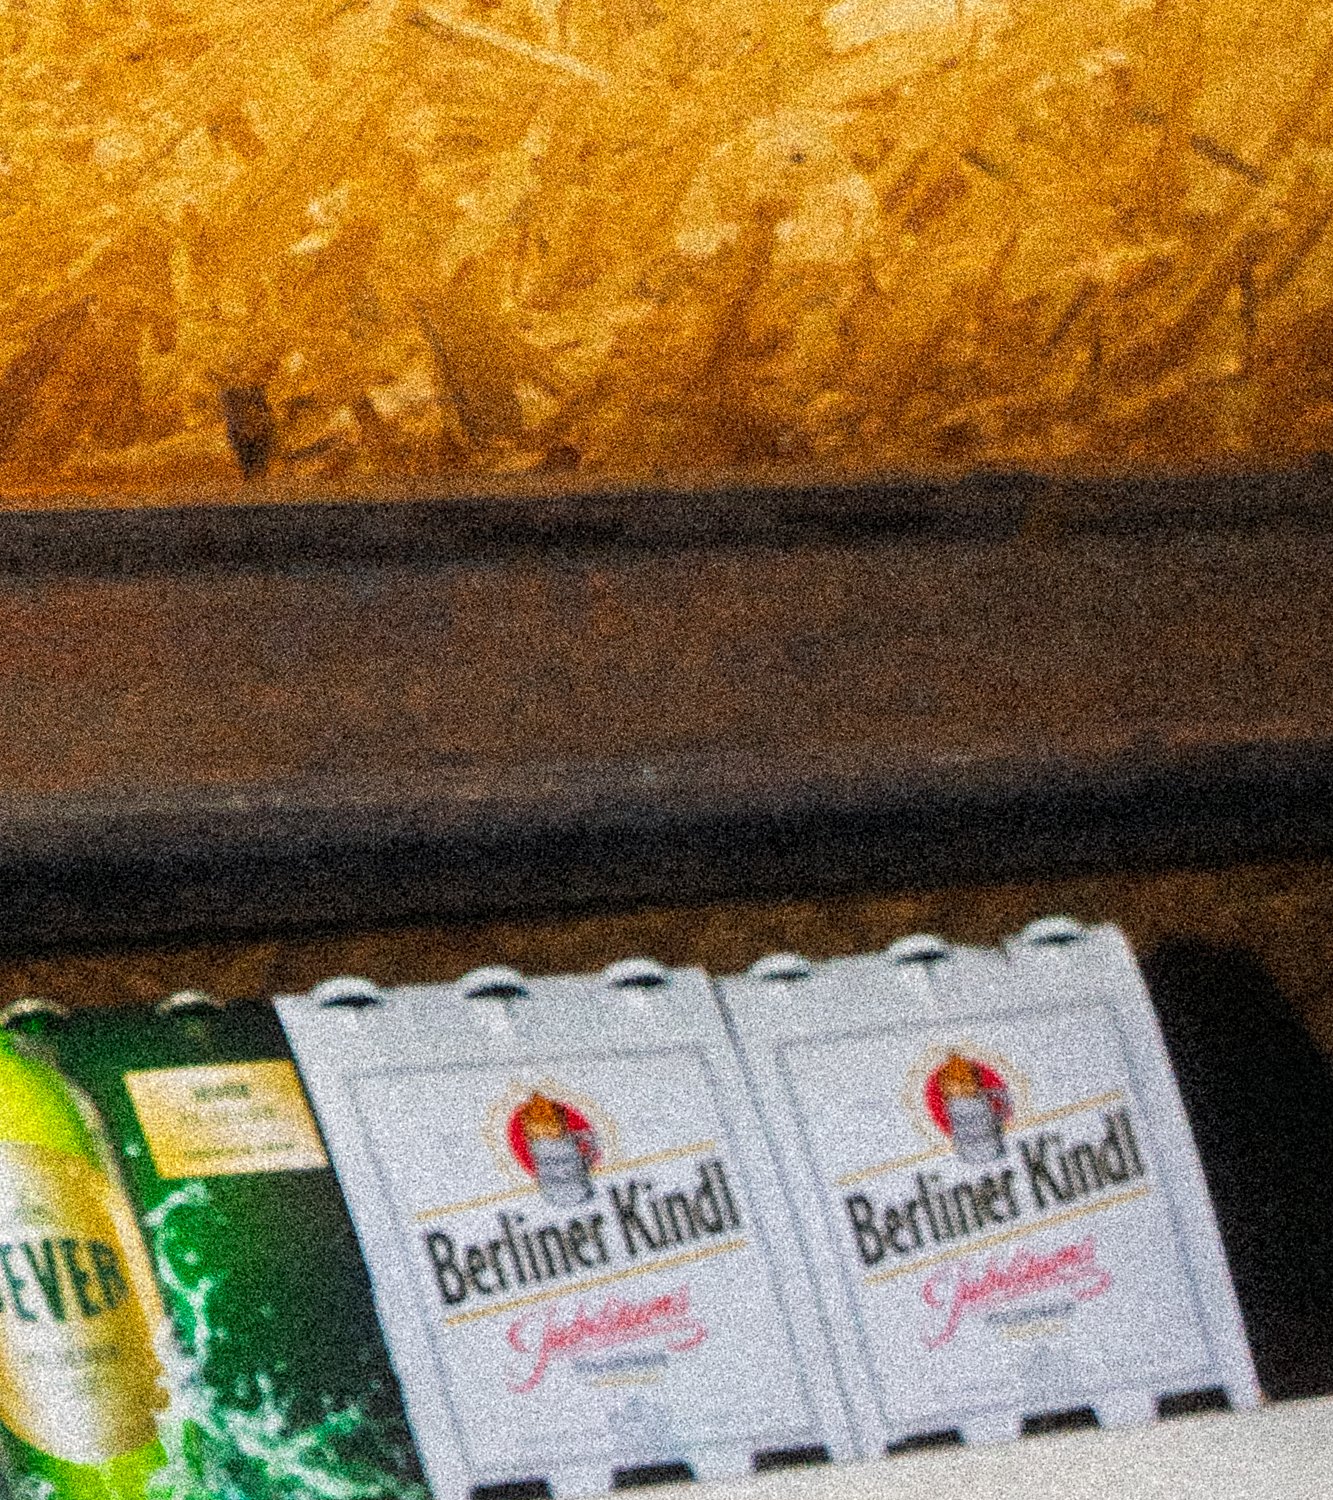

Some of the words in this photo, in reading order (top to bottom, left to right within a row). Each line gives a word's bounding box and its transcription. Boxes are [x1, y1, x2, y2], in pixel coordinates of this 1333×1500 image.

[423, 1210, 611, 1309] Berliner
[608, 1157, 743, 1260] Kindl
[844, 1170, 1021, 1269] Berliner
[1017, 1105, 1147, 1213] Kindl
[0, 1237, 128, 1325] EVER
